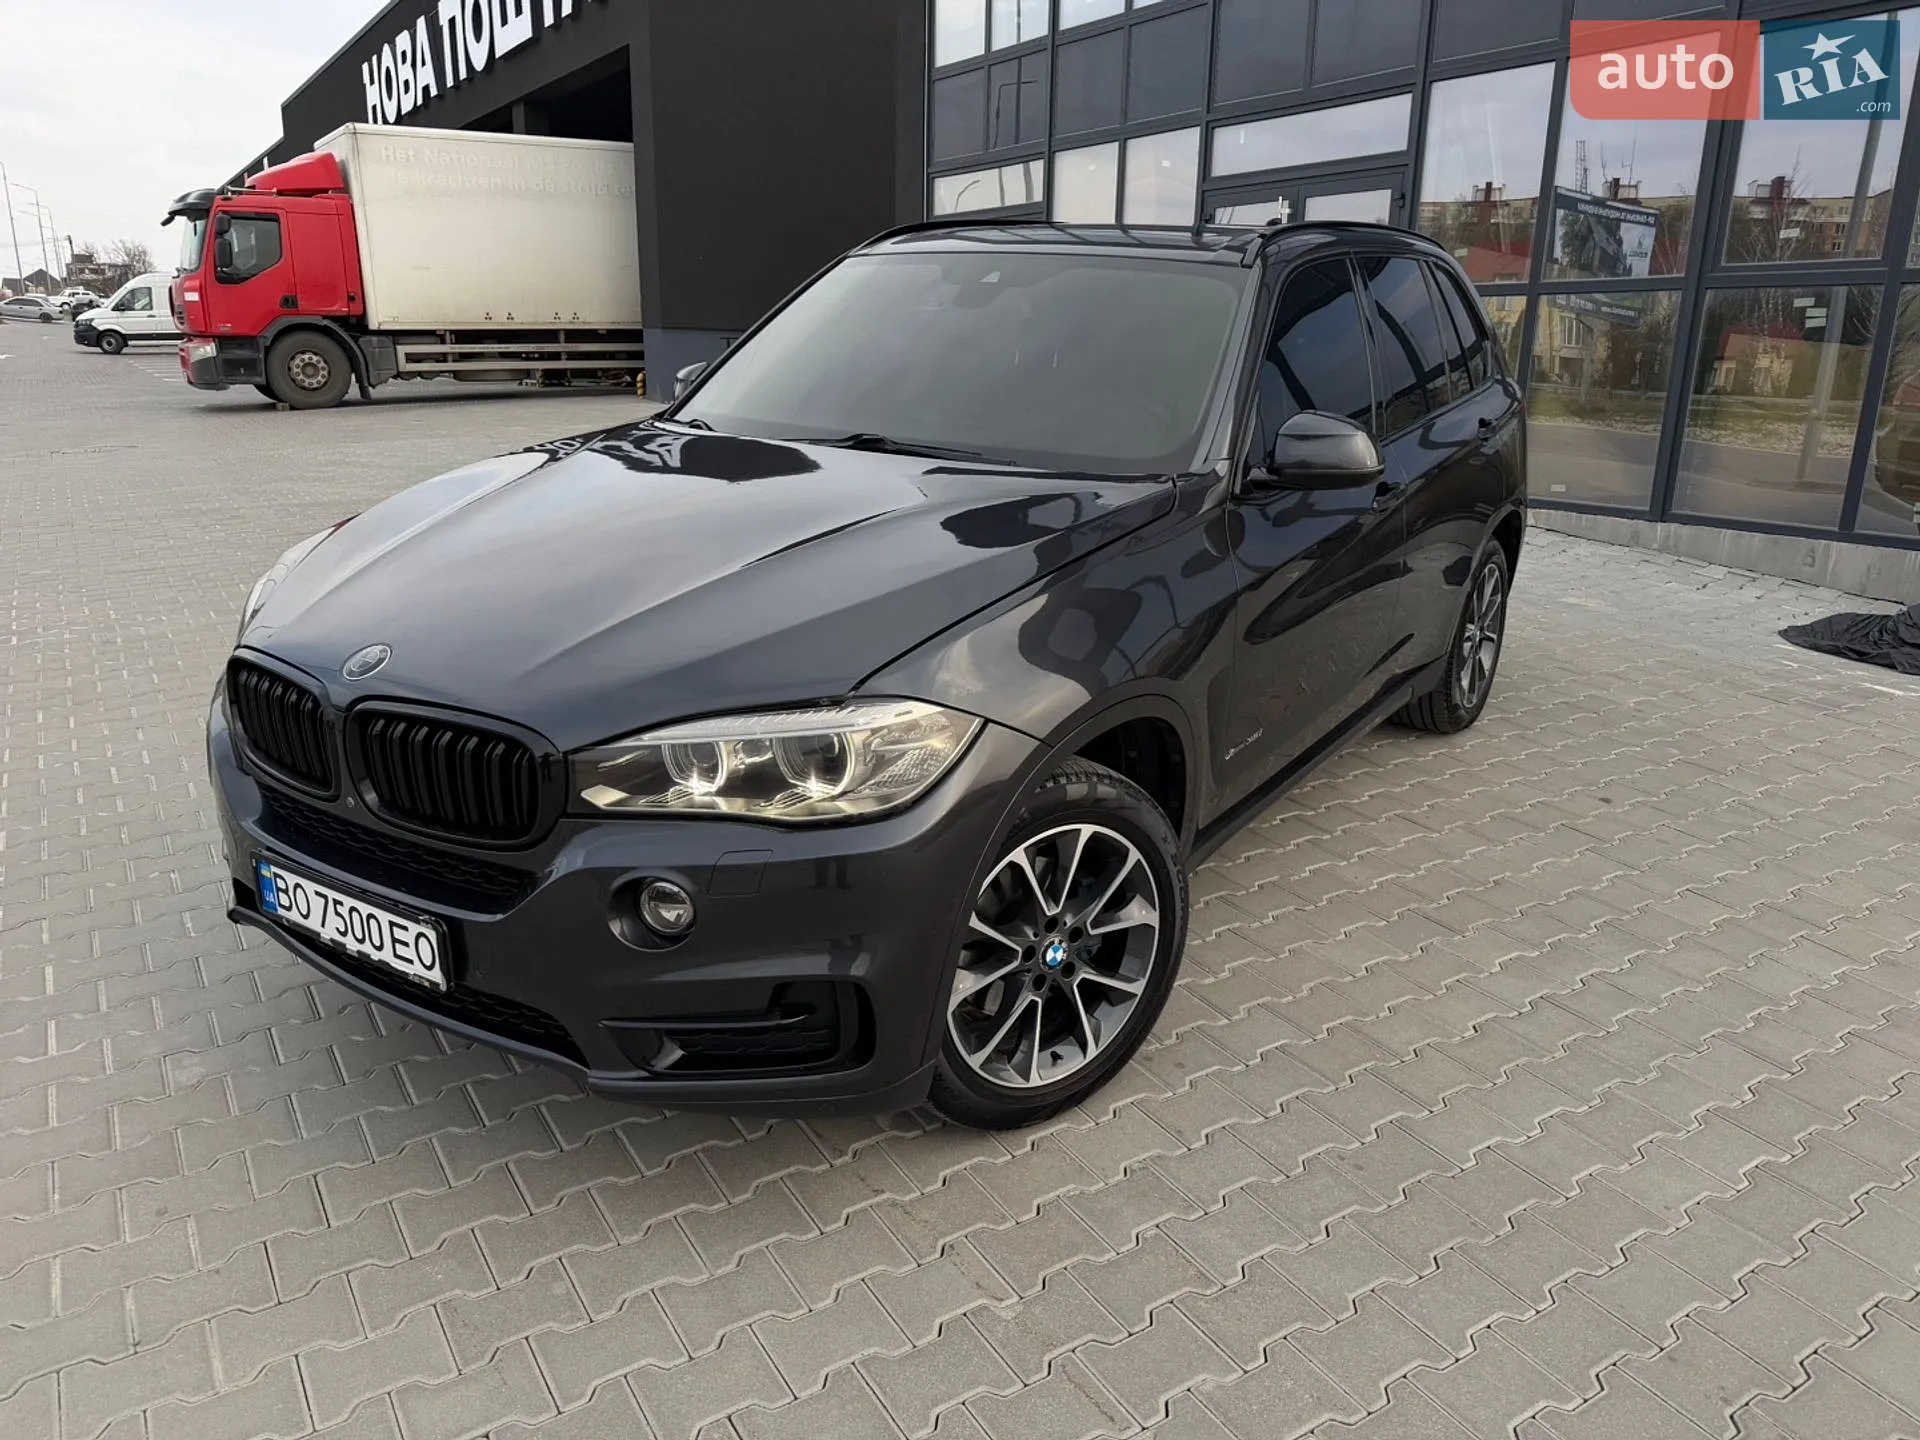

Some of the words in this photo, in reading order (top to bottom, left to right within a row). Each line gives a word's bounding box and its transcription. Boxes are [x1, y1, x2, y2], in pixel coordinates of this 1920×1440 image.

[362, 15, 438, 125] НОВА
[381, 145, 416, 163] Het
[424, 148, 519, 171] Nationaal
[415, 167, 504, 190] krachten
[508, 174, 527, 192] in
[533, 176, 555, 194] de
[263, 889, 276, 903] UA
[272, 871, 311, 920] BO
[314, 890, 384, 952] 7500
[388, 919, 436, 971] EO
